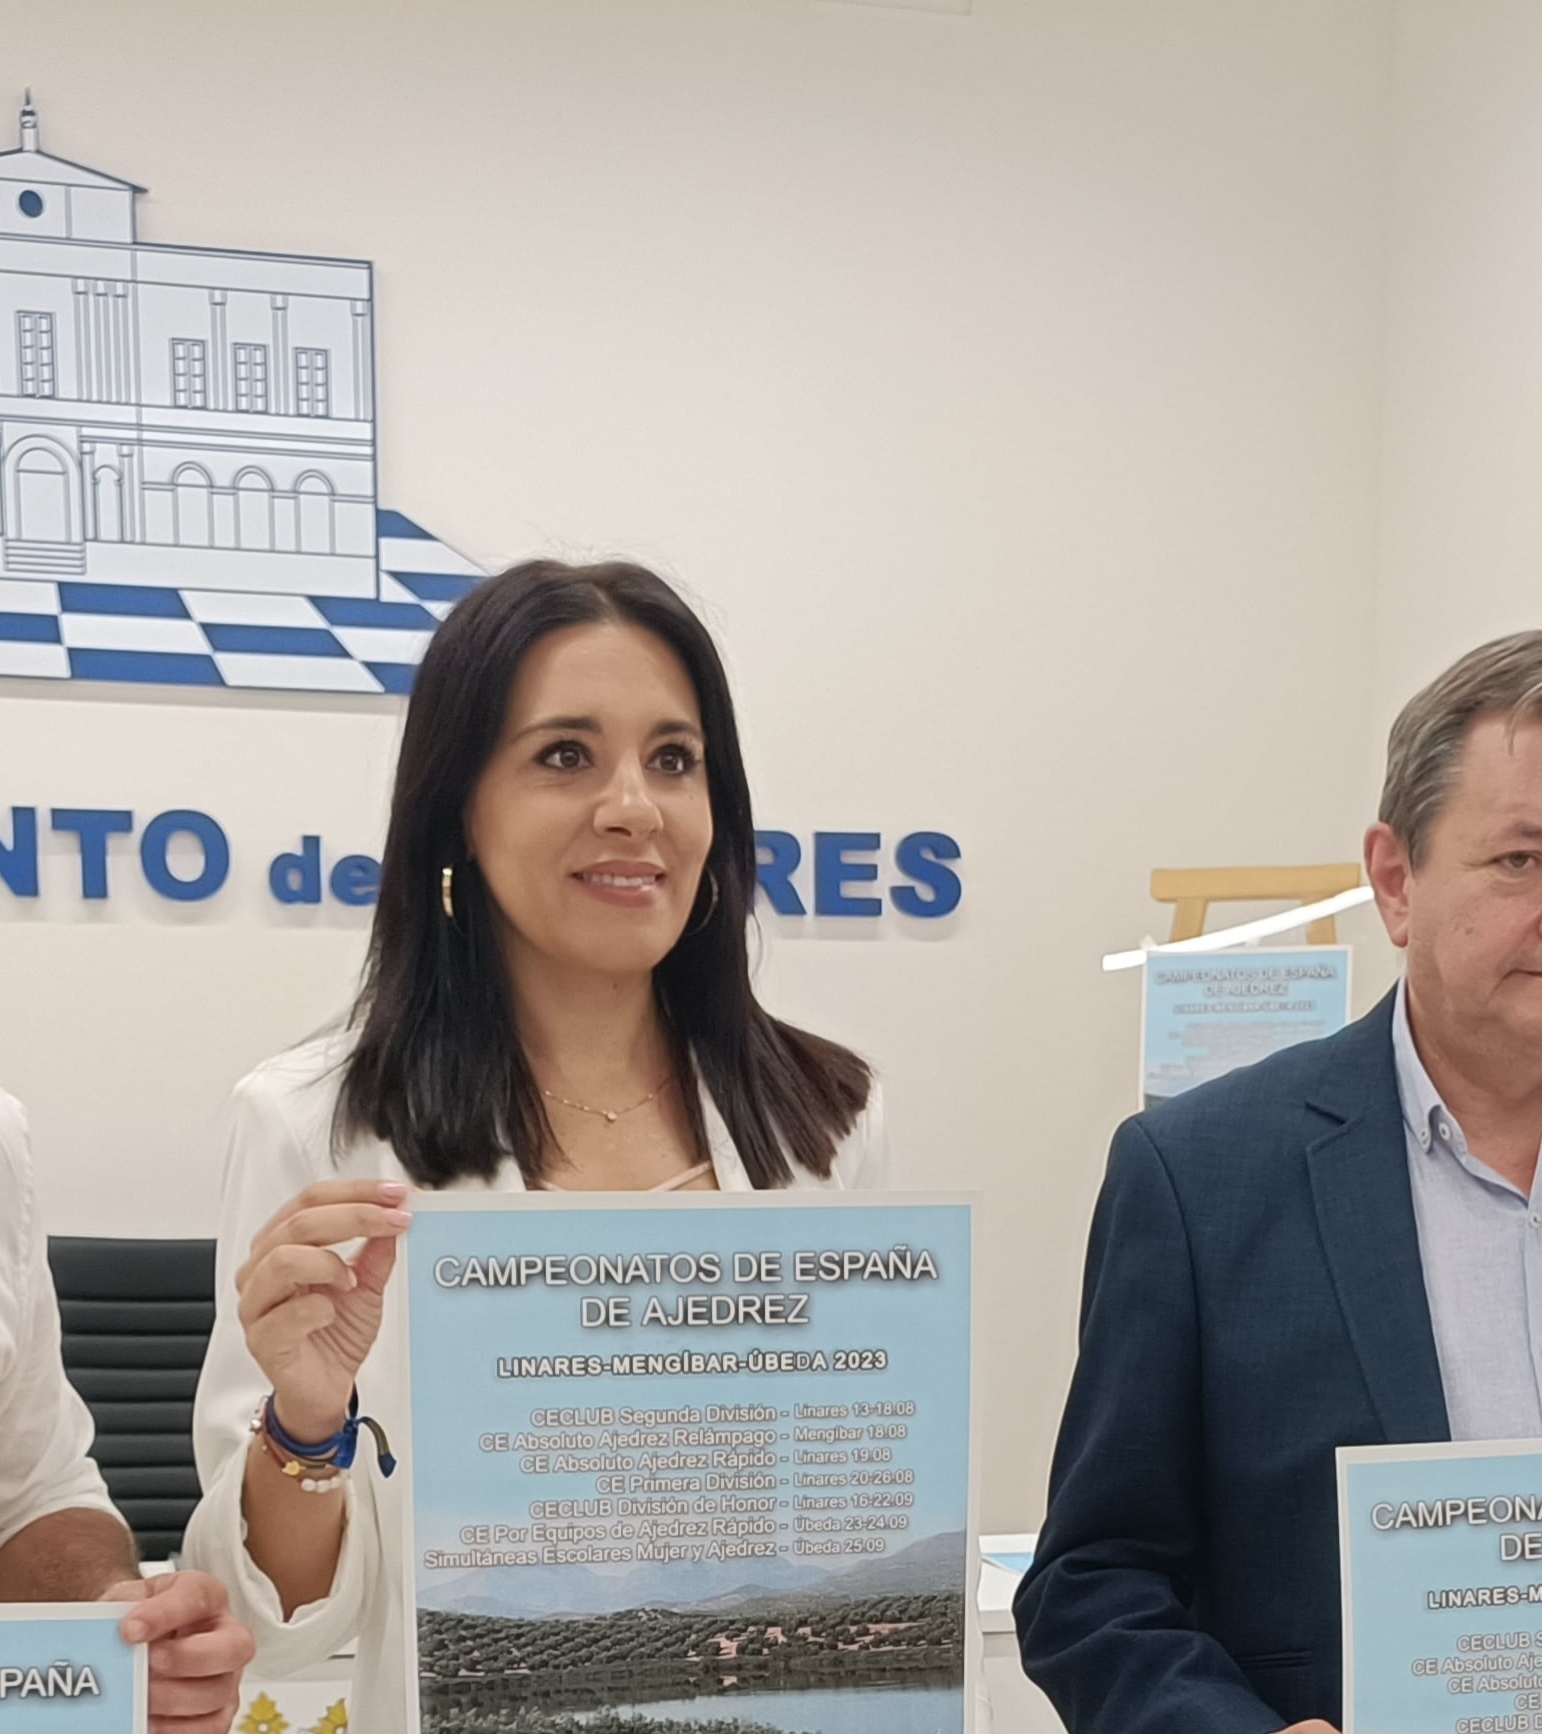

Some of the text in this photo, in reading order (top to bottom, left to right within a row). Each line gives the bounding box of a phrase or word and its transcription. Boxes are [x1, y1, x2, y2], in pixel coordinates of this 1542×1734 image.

[433, 1245, 937, 1287] CAMPEONATOS DE ESPAÑA
[581, 1293, 808, 1328] DE AJEDREZ
[497, 1348, 887, 1378] LINARES-MENGÍBAR-ÚBEDA 2023
[531, 1400, 915, 1428] CECLUB Segunda División Linares 13-18.08
[478, 1433, 508, 1452] CE
[512, 1431, 593, 1451] Absoluto
[598, 1429, 668, 1451] Ajedrez
[673, 1426, 776, 1449] Relámpago
[866, 1424, 907, 1439] 18.08
[520, 1447, 891, 1473] CE Absoluto Ajedrez Rápido Linares 19.08
[596, 1469, 914, 1493] CE Primera División Linares 20-26.08
[529, 1492, 914, 1518] CECLUB División de Honor Linares 16-22.09
[461, 1526, 489, 1544] CE
[494, 1525, 527, 1543] Por
[531, 1523, 606, 1545] Equipos
[610, 1522, 633, 1539] de
[638, 1520, 707, 1542] Ajedrez
[712, 1517, 776, 1539] Rápido
[844, 1514, 908, 1530] 23-24.09
[423, 1549, 537, 1569] Simultáneas
[542, 1544, 631, 1564] Escolares
[636, 1542, 688, 1564] Mujer
[692, 1546, 703, 1562] y
[706, 1539, 776, 1562] Ajedrez
[844, 1537, 884, 1553] 25.09
[1457, 1632, 1530, 1652] CECLUB
[1411, 1659, 1437, 1676] CE
[1441, 1654, 1512, 1674] Absoluto
[1447, 1677, 1473, 1694] CE
[1514, 1693, 1540, 1710] CE
[1455, 1714, 1529, 1734] CECLUB
